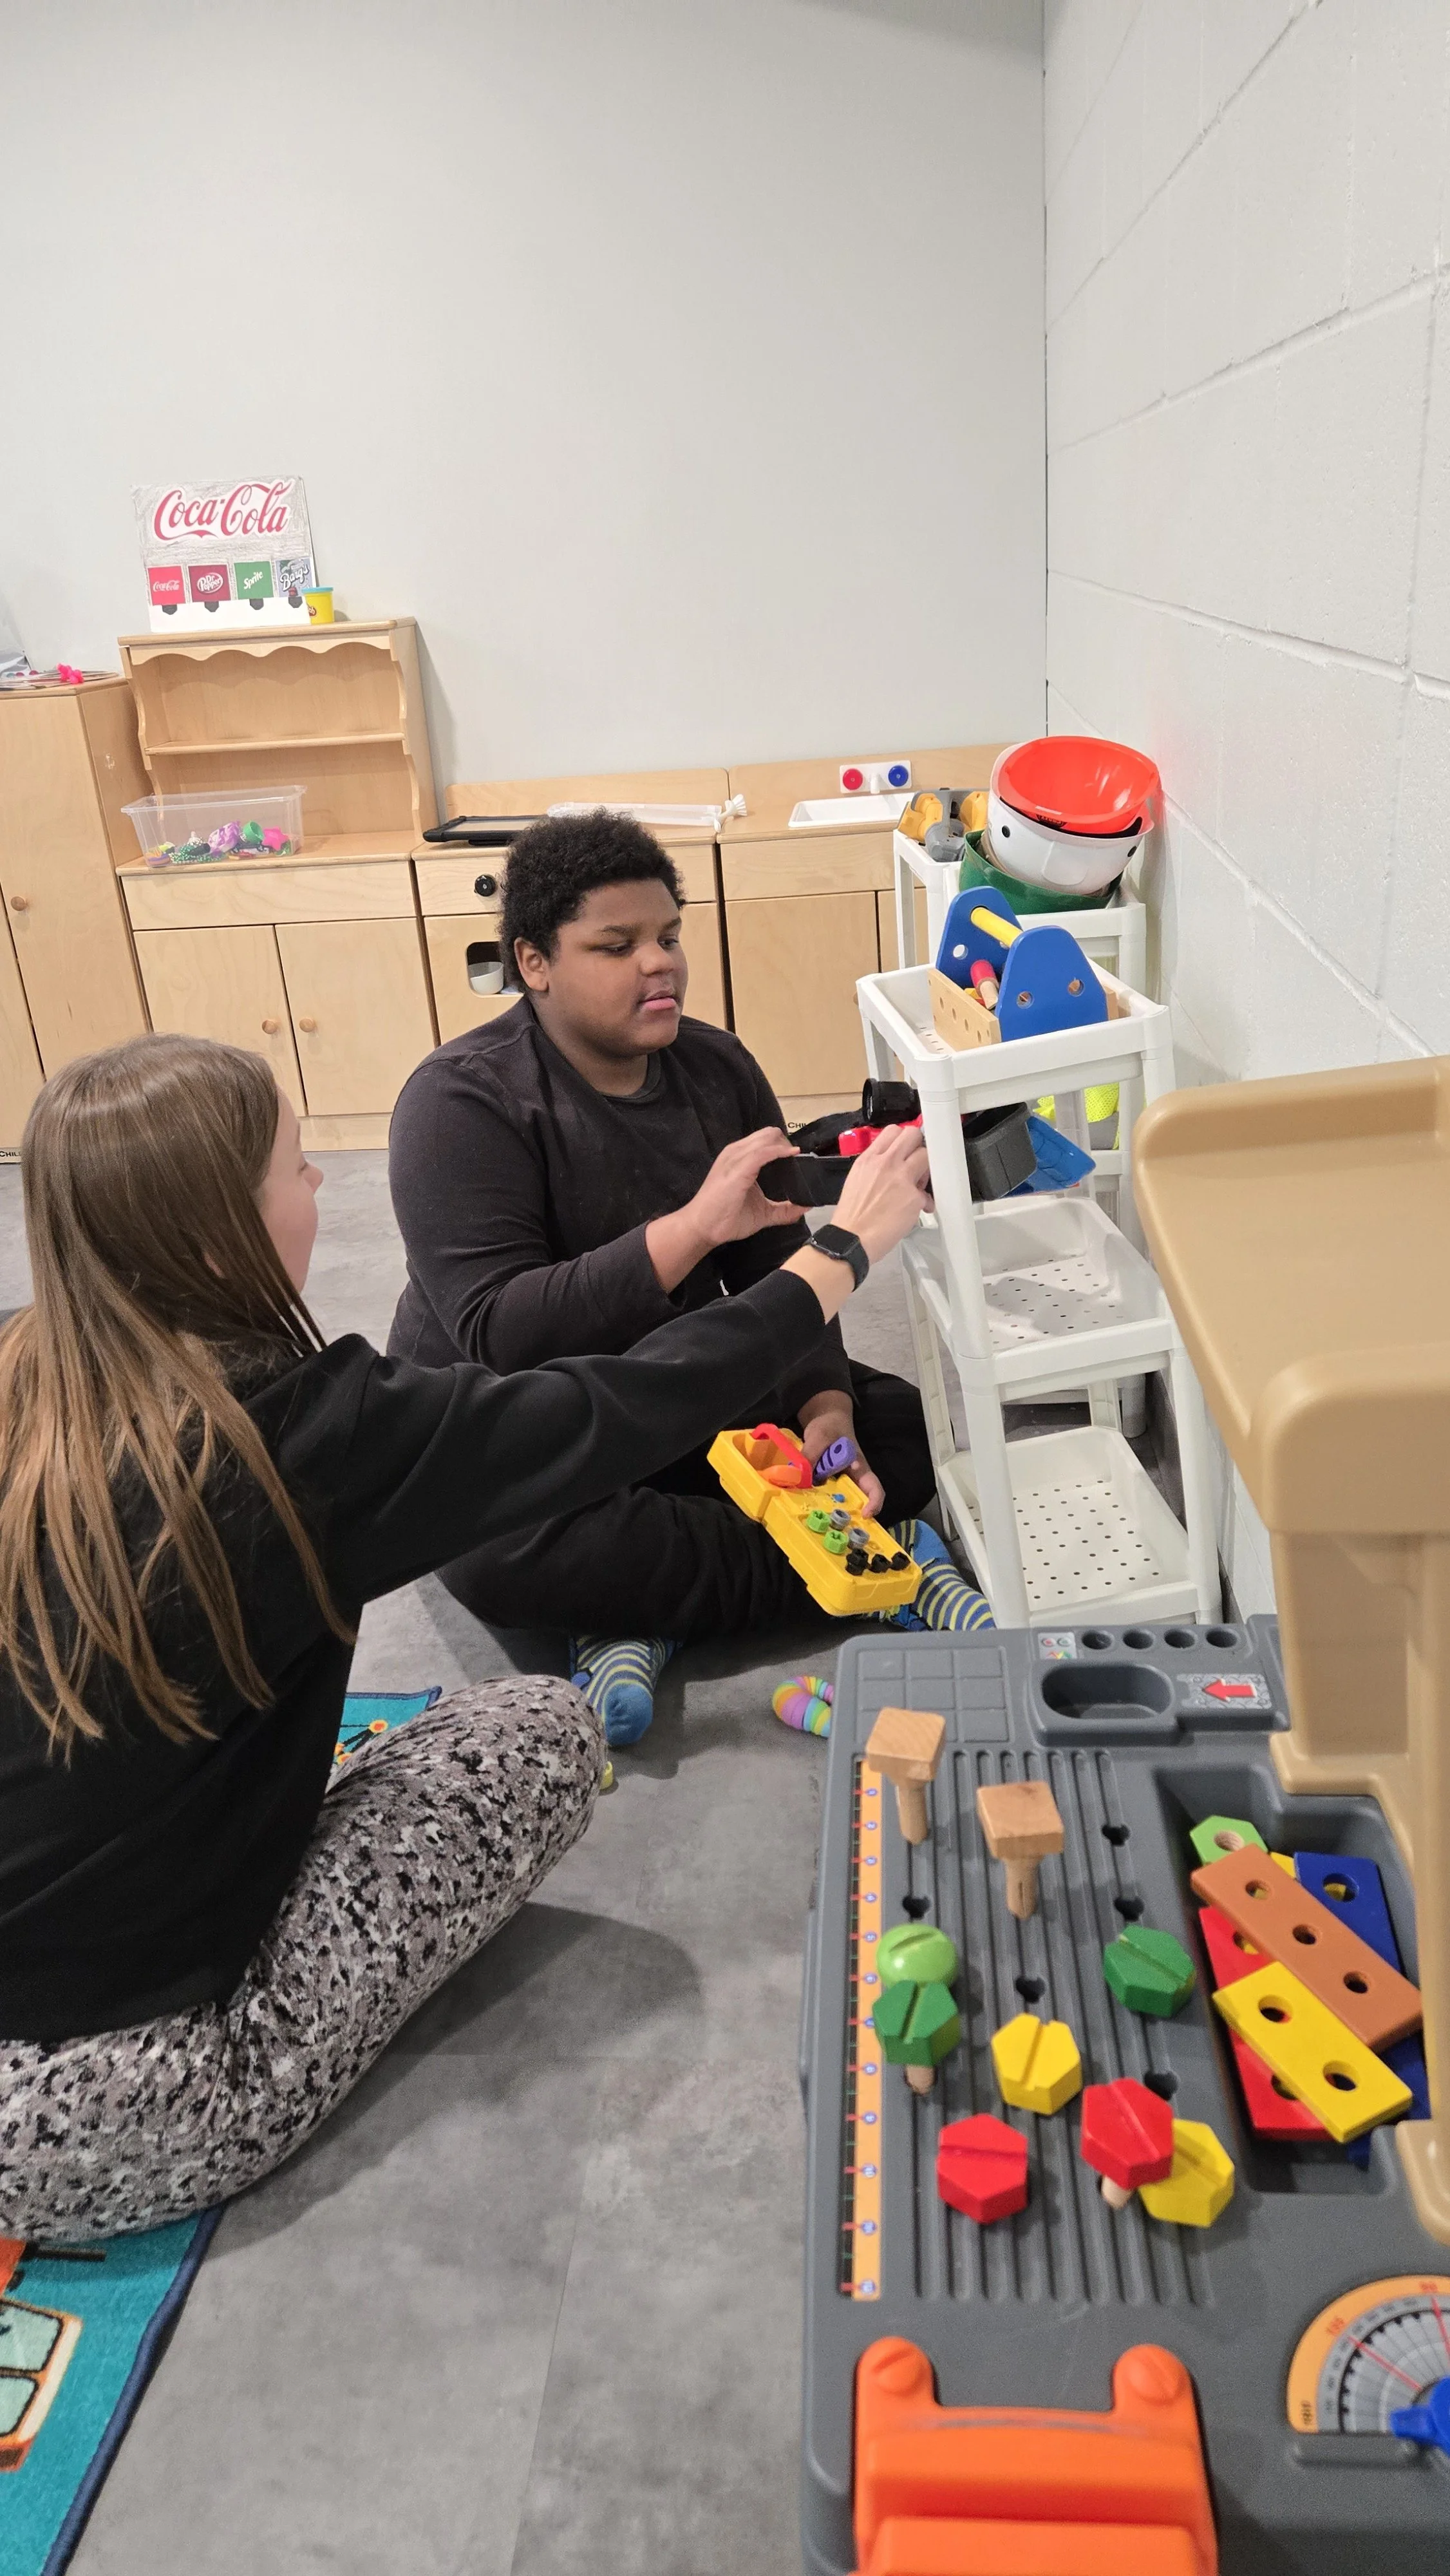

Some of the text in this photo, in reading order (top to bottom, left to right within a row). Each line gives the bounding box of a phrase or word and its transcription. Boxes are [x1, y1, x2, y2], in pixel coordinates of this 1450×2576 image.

[199, 577, 221, 592] Pepper
[205, 574, 215, 583] Dr
[243, 571, 263, 590] Sprite
